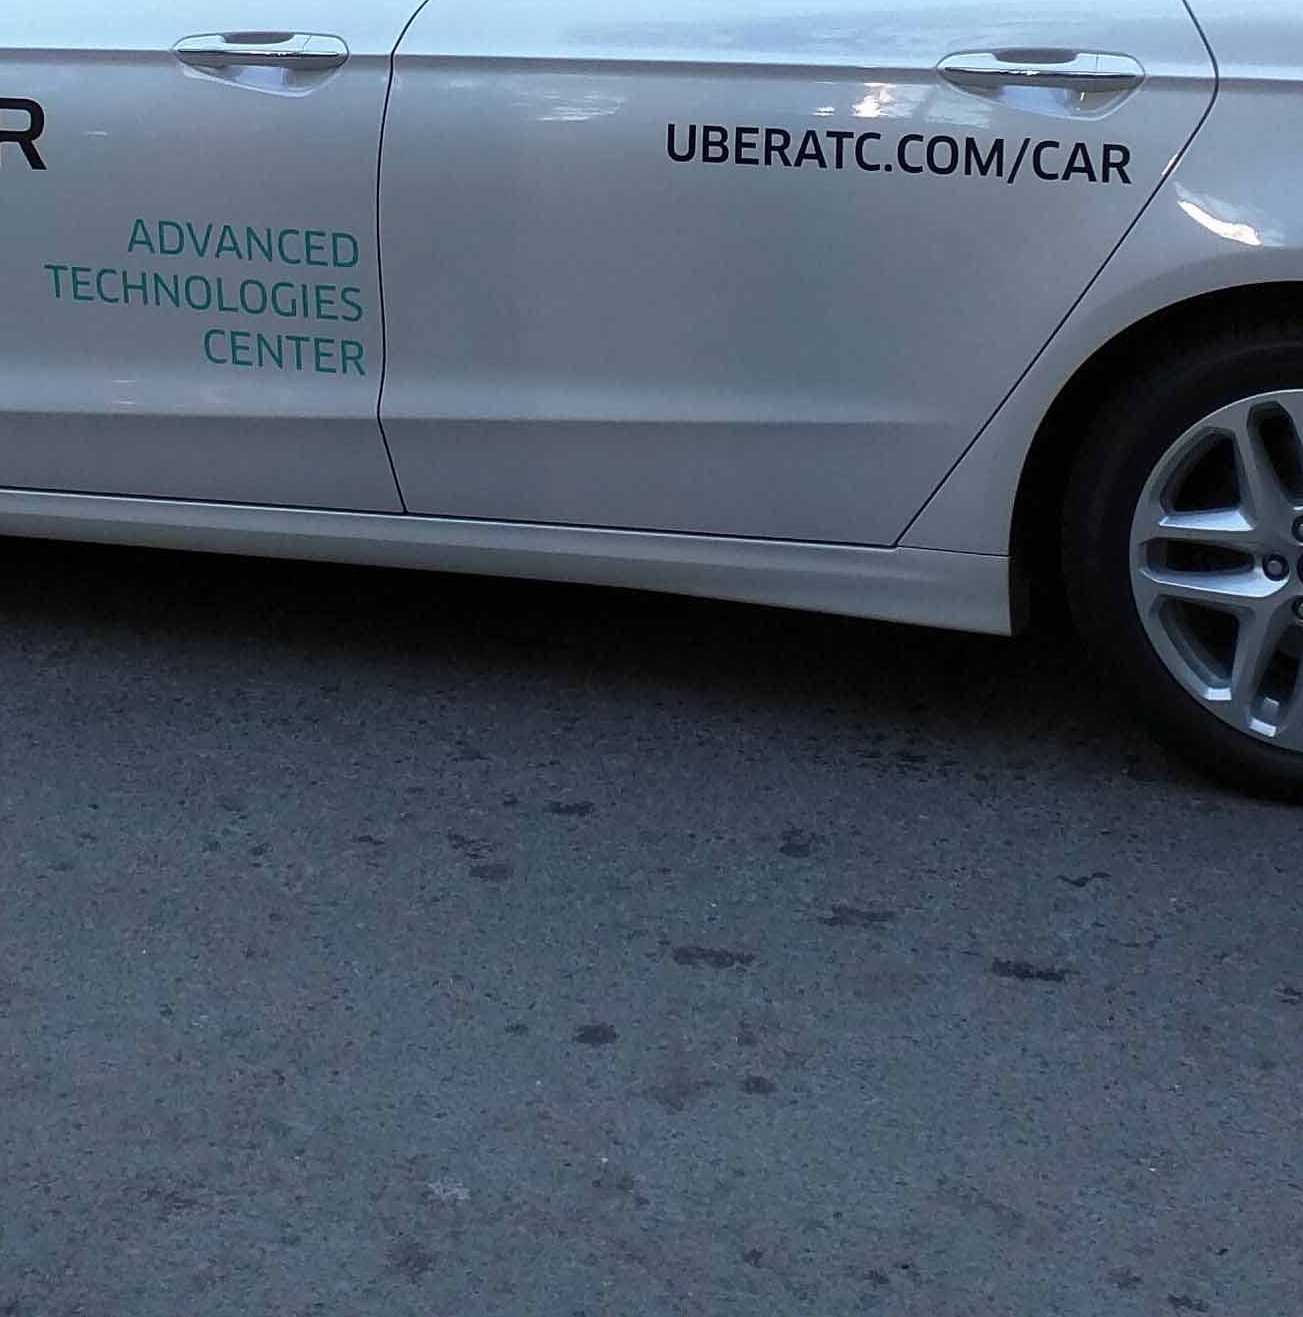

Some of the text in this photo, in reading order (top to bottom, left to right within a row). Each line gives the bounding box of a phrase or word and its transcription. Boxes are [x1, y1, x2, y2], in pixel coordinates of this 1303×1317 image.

[666, 122, 1132, 185] UBERATC.COM/CAR
[127, 217, 360, 269] ADVANCED
[44, 263, 365, 323] TECHNOLOGIES
[203, 328, 367, 377] CENTER
